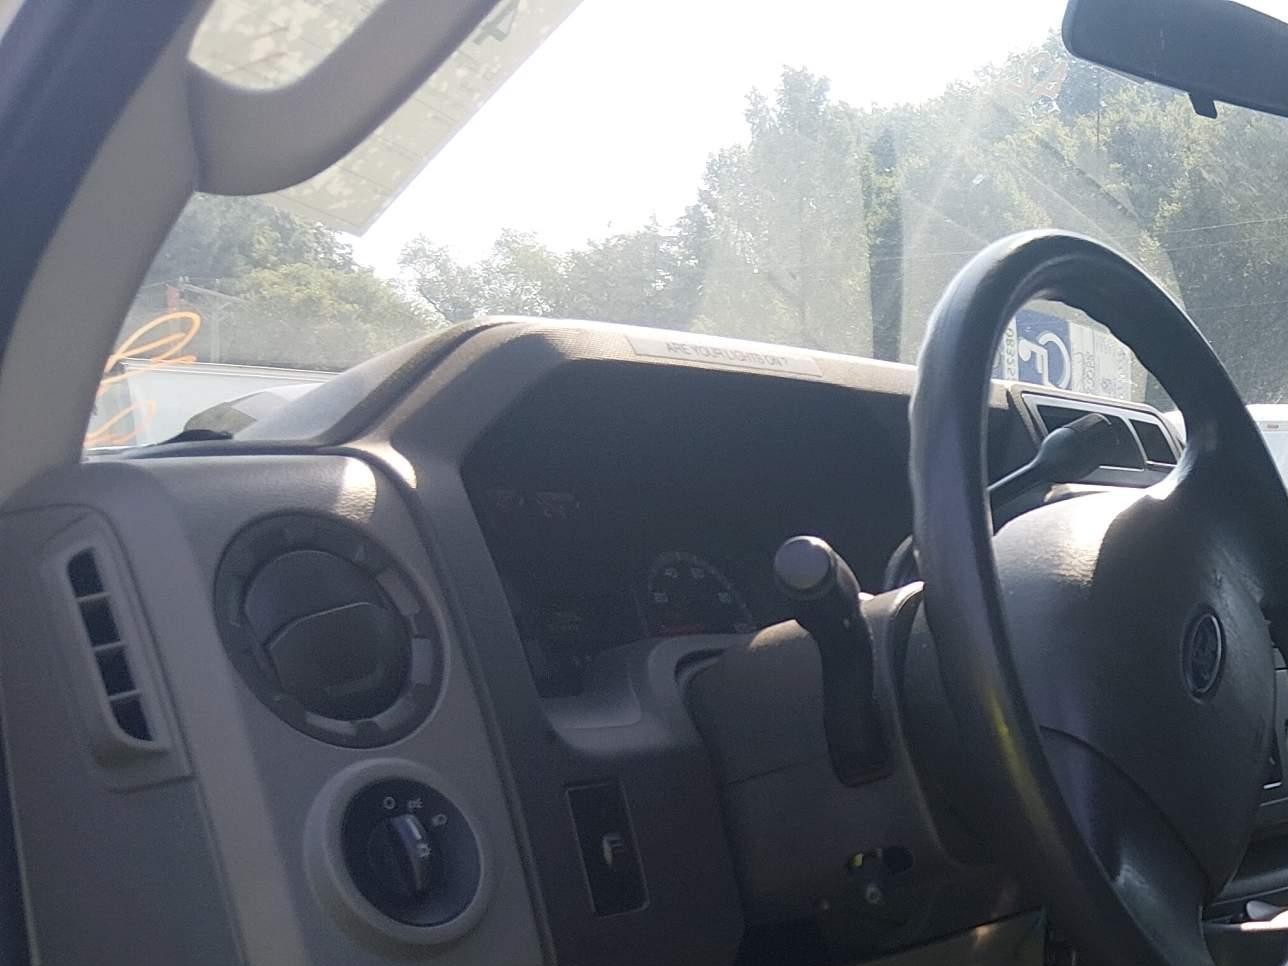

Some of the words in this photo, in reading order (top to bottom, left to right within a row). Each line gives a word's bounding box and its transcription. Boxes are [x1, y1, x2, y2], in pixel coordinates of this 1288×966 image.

[665, 342, 690, 354] ARE
[690, 344, 726, 359] YOUR
[726, 348, 765, 365] LIGHTS
